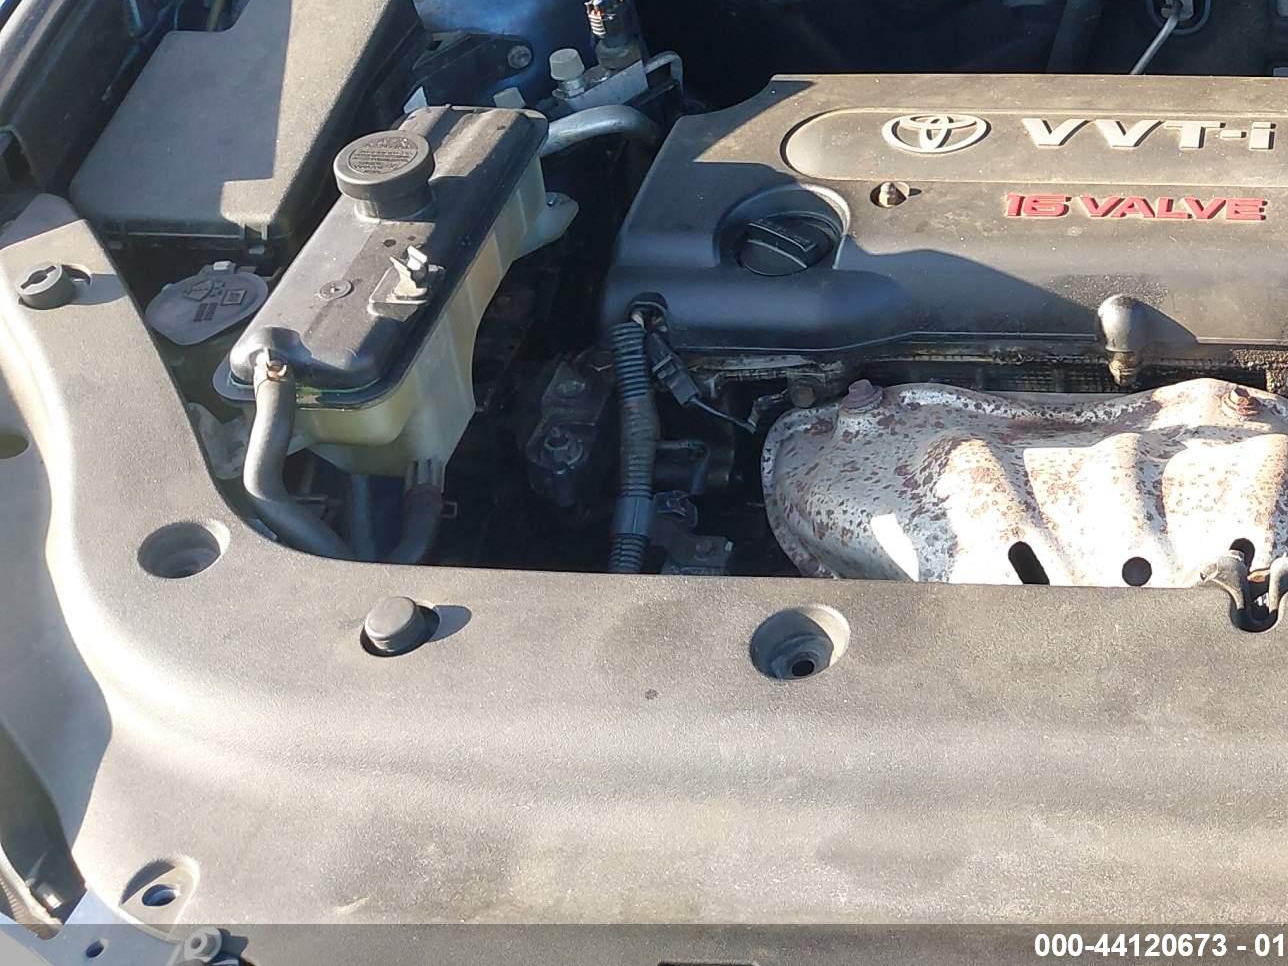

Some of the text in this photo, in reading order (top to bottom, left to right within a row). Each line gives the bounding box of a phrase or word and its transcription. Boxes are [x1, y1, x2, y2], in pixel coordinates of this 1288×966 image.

[1021, 117, 1277, 151] VVT-i
[1005, 193, 1269, 222] 16 VALVE
